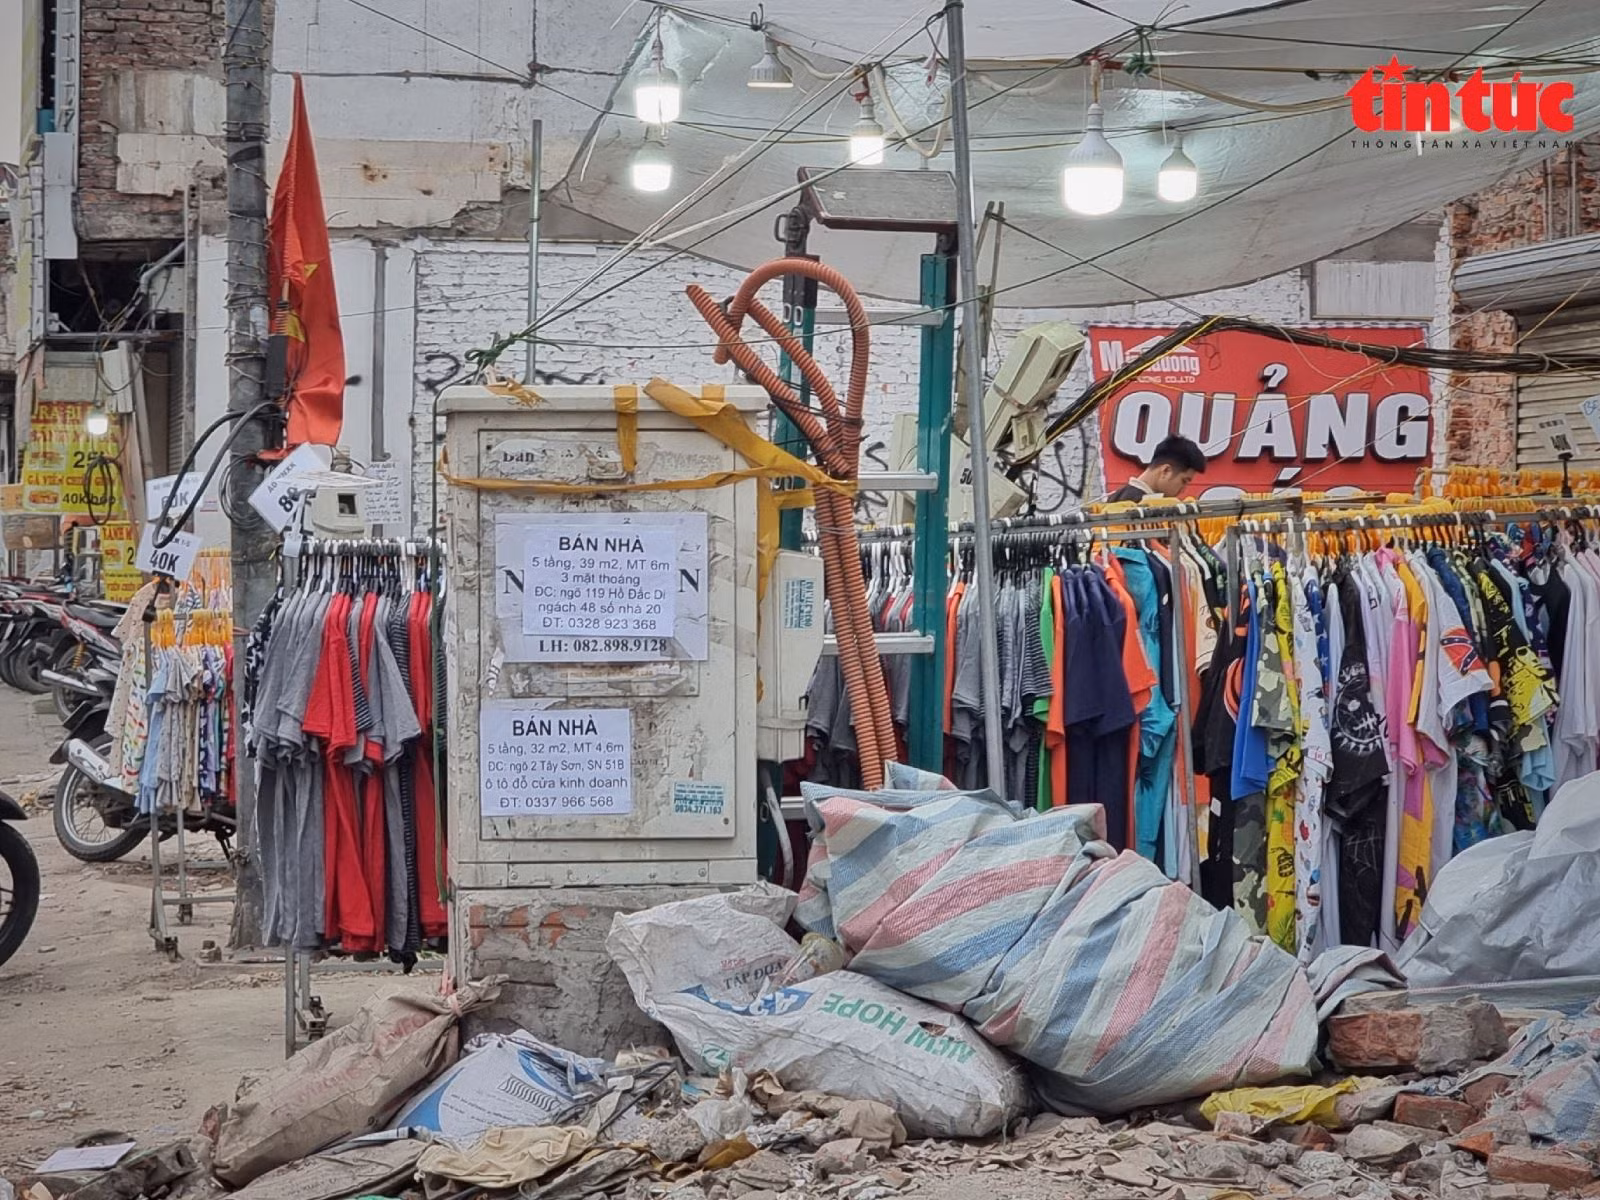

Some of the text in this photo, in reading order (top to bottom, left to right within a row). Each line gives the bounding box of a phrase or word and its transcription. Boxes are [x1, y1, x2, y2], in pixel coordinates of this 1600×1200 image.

[1112, 363, 1432, 465] QUẢNG
[559, 533, 644, 553] BÁN NHÀ
[150, 549, 180, 573] 40K
[532, 555, 670, 571] 5 tầng, 39 m2, MT 6m
[561, 572, 569, 583] 3
[599, 573, 640, 587] thoáng
[534, 586, 556, 598] ĐC:
[586, 588, 605, 599] 119
[538, 601, 576, 614] ngách
[580, 602, 596, 613] 48
[600, 600, 615, 614] số
[646, 604, 661, 614] 20
[542, 617, 657, 630] ĐT: 0328 923 368
[539, 638, 667, 653] LH: 082.898.9128
[512, 714, 598, 736] BÁN NHÀ
[487, 743, 495, 754] 5
[498, 741, 527, 757] tầng,
[530, 743, 545, 754] 32
[548, 743, 570, 755] m2,
[574, 742, 592, 753] MT
[488, 761, 507, 772] ĐC:
[531, 761, 537, 771] 2
[540, 761, 558, 773] Tây
[561, 760, 584, 772] Sơn,
[587, 760, 602, 770] SN
[605, 760, 624, 770] 51B
[485, 778, 493, 790] ô
[497, 778, 508, 789] tô
[560, 777, 585, 788] kinh
[589, 777, 628, 788] doanh
[500, 796, 614, 808] ĐT: 0337 966 568
[817, 992, 908, 1036] HOPE
